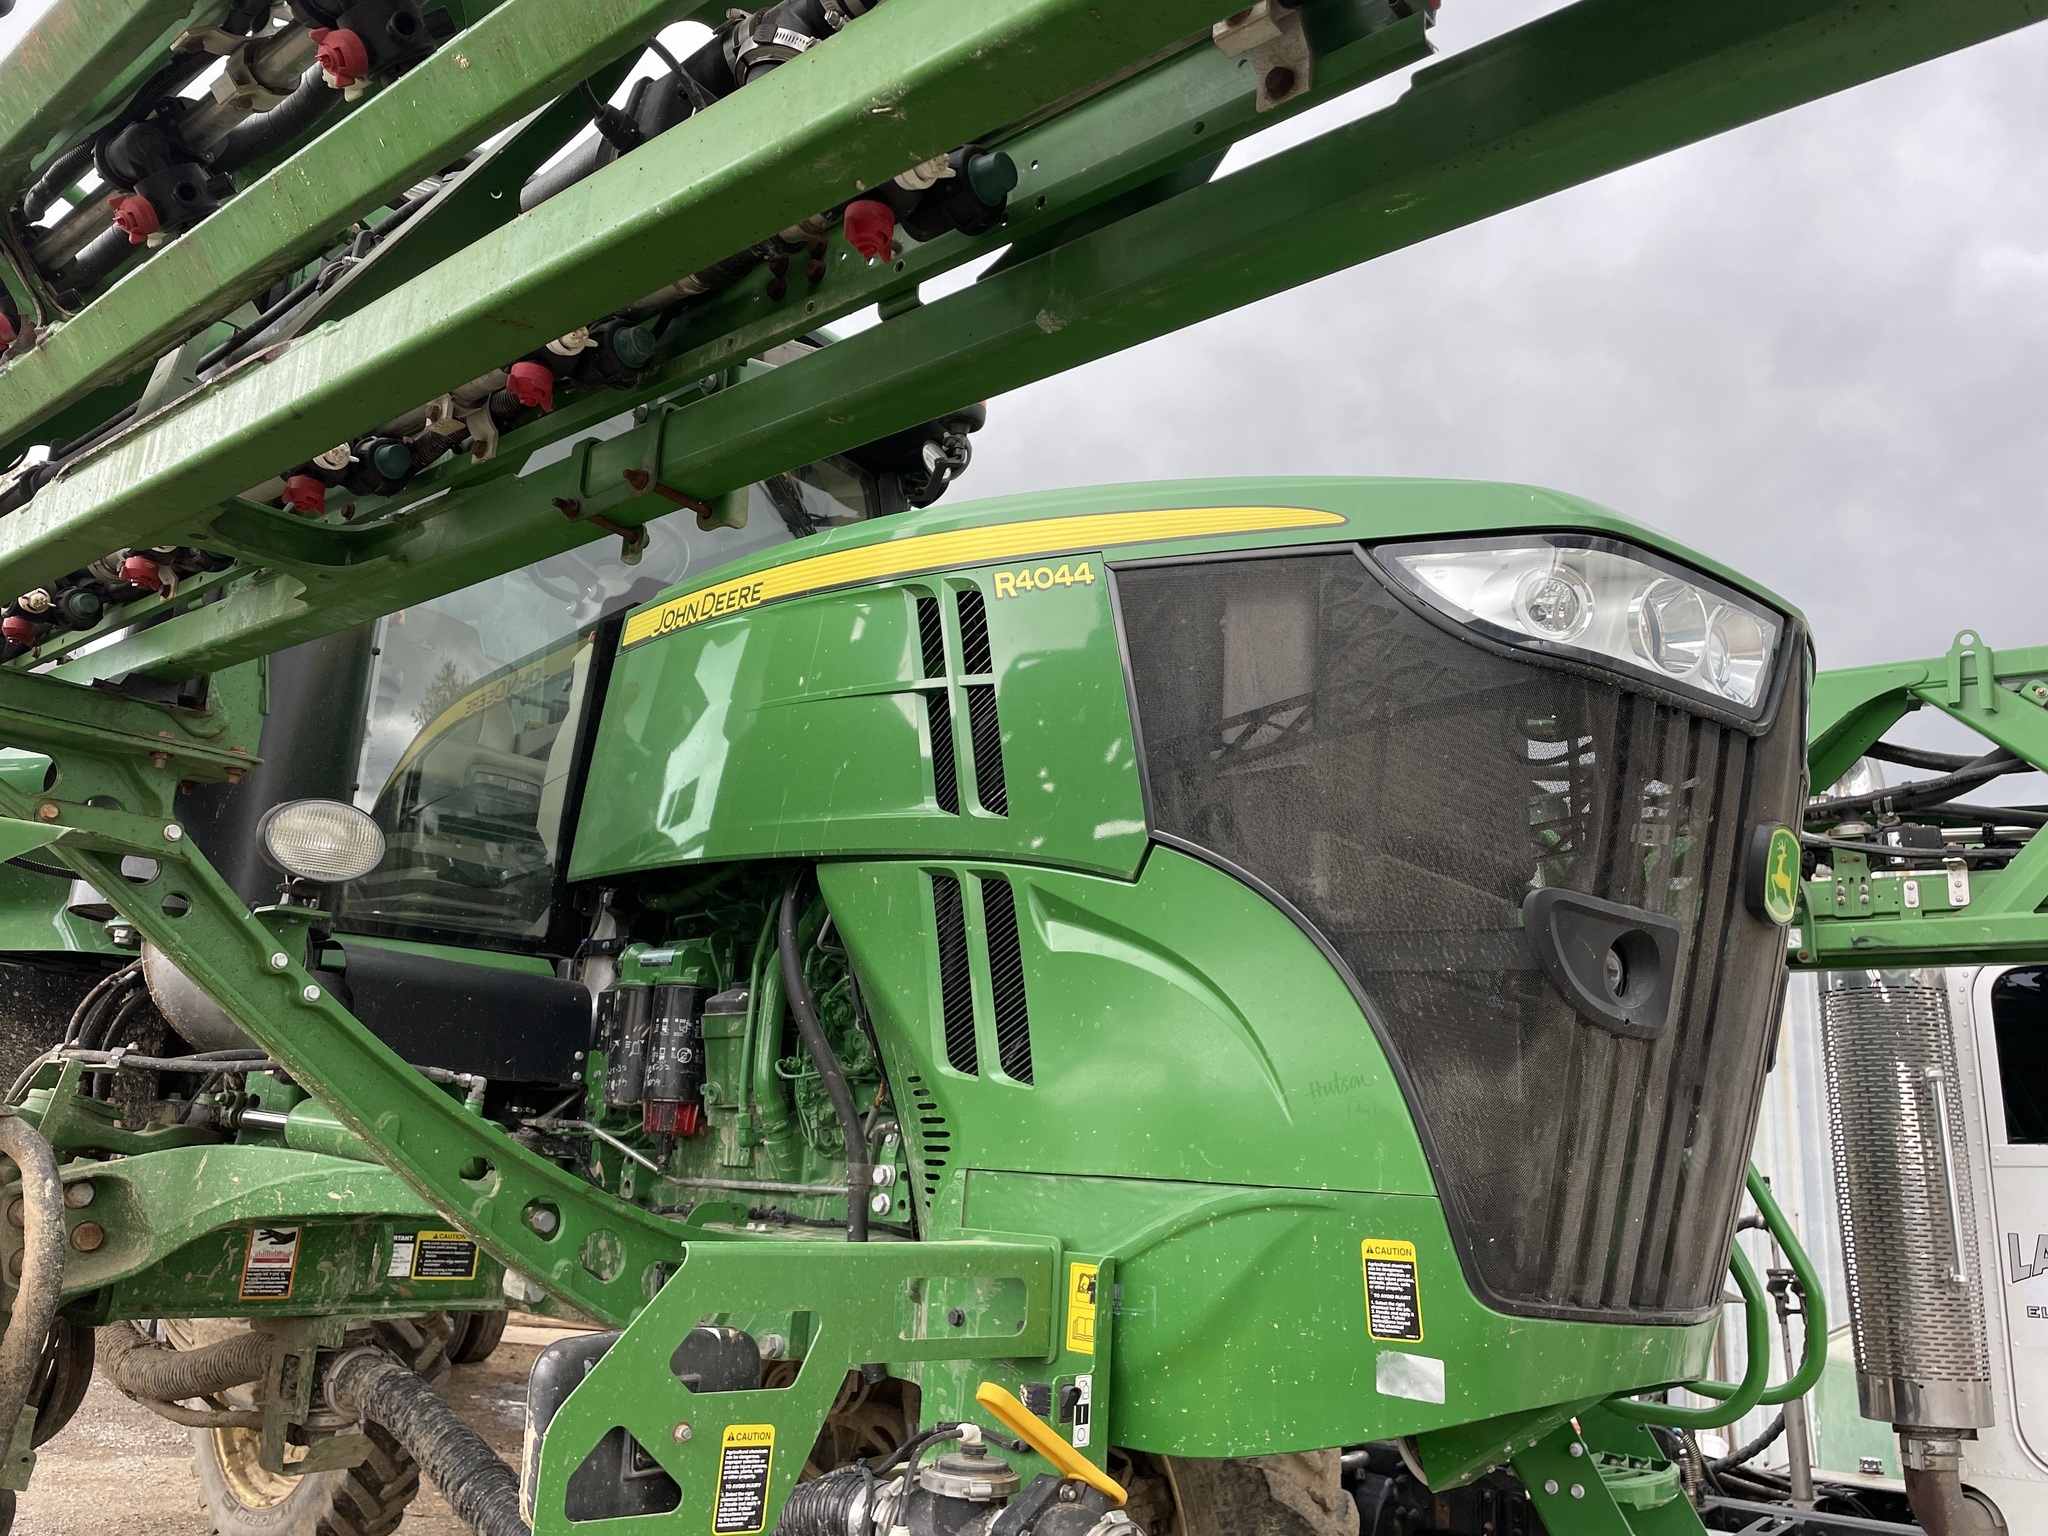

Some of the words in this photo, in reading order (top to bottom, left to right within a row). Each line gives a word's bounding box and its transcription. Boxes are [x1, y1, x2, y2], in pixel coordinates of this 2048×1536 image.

[994, 562, 1095, 600] R4044
[654, 600, 700, 633] JOHN
[700, 581, 764, 618] DEERE
[1374, 1246, 1412, 1256] CAUTION
[736, 1432, 772, 1441] CAUTION
